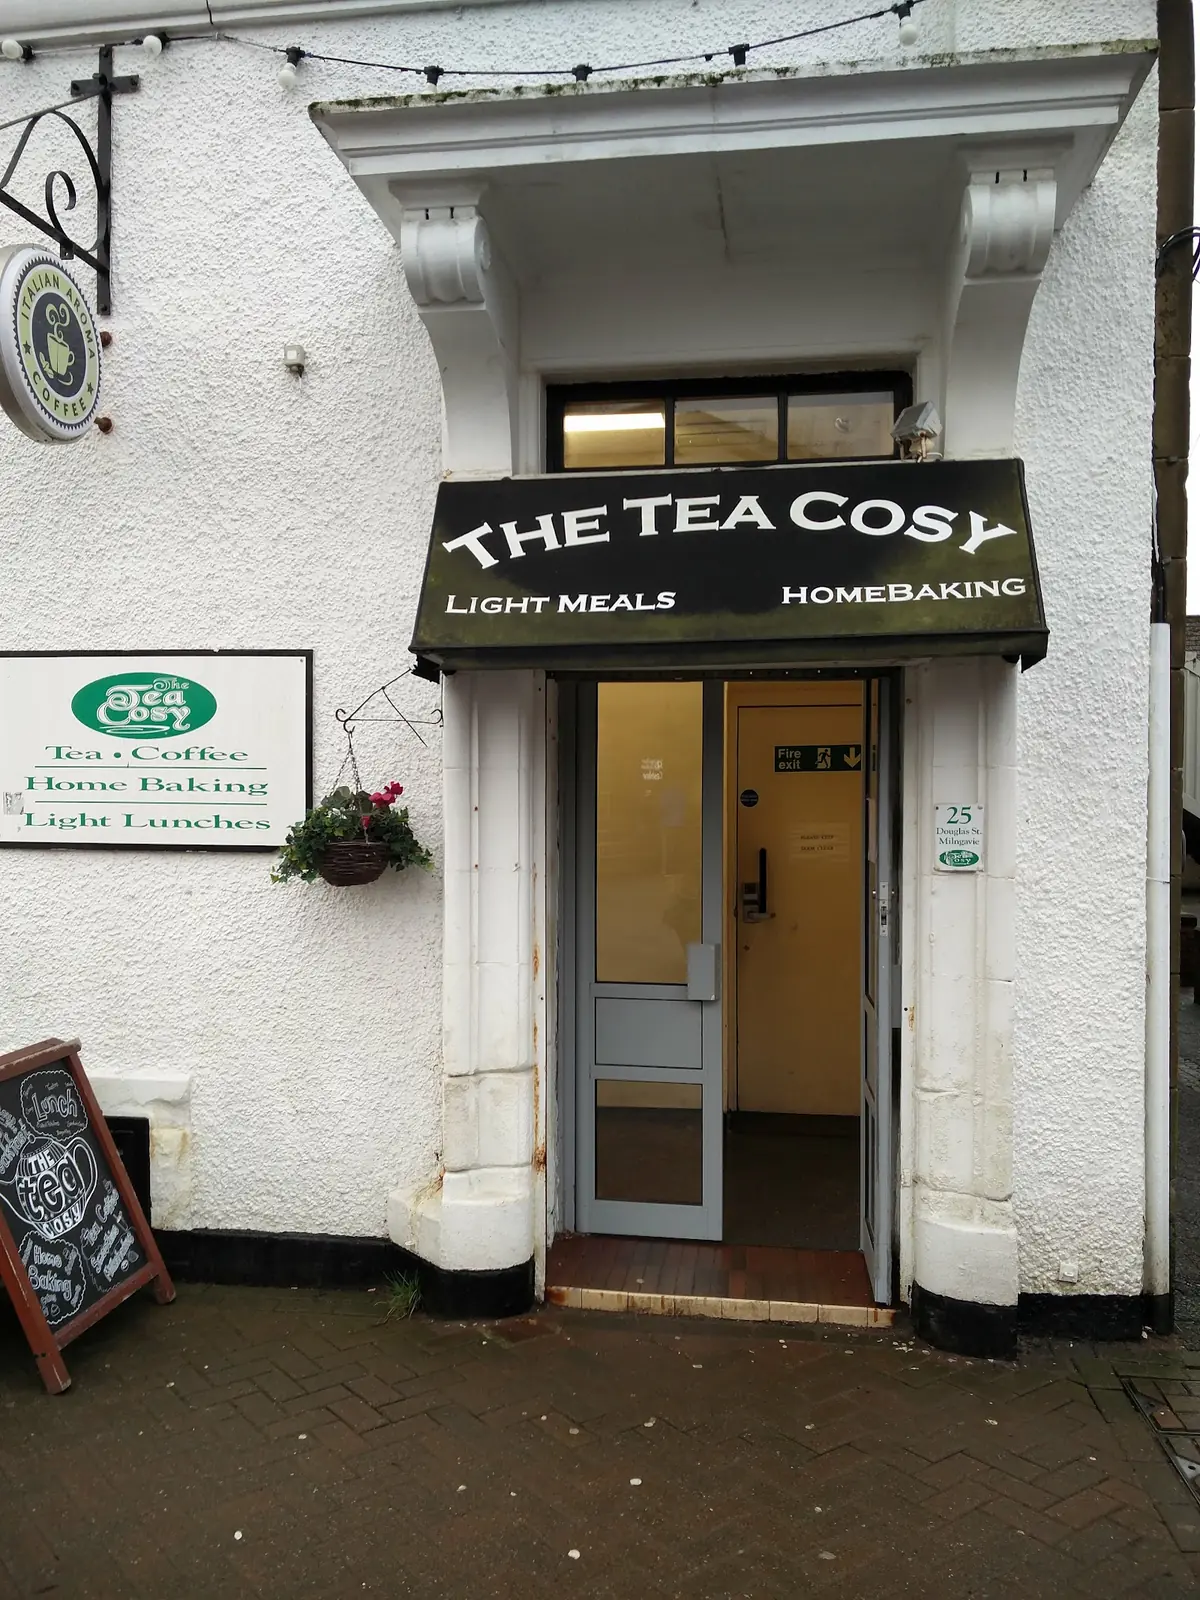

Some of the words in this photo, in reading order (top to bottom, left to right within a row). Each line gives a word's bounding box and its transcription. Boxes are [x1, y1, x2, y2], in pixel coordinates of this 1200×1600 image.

[21, 273, 60, 320] ITALIAN
[66, 288, 95, 360] AROMA
[32, 371, 87, 417] COFFEE
[153, 677, 190, 692] The
[106, 684, 187, 712] Tea
[96, 703, 192, 731] Cosy
[45, 746, 103, 760] Tea
[131, 746, 249, 761] Coffee
[778, 748, 801, 758] Fire
[778, 759, 800, 770] exit
[24, 776, 127, 791] Home
[139, 777, 269, 796] Baking
[24, 812, 111, 830] Light
[123, 813, 271, 830] Lunches
[946, 805, 972, 825] 25
[936, 827, 970, 837] Douglas
[31, 1088, 78, 1122] Lunch
[28, 1149, 55, 1175] THE
[18, 1155, 85, 1221] tea
[33, 1244, 63, 1269] Home
[28, 1265, 73, 1302] Baking
